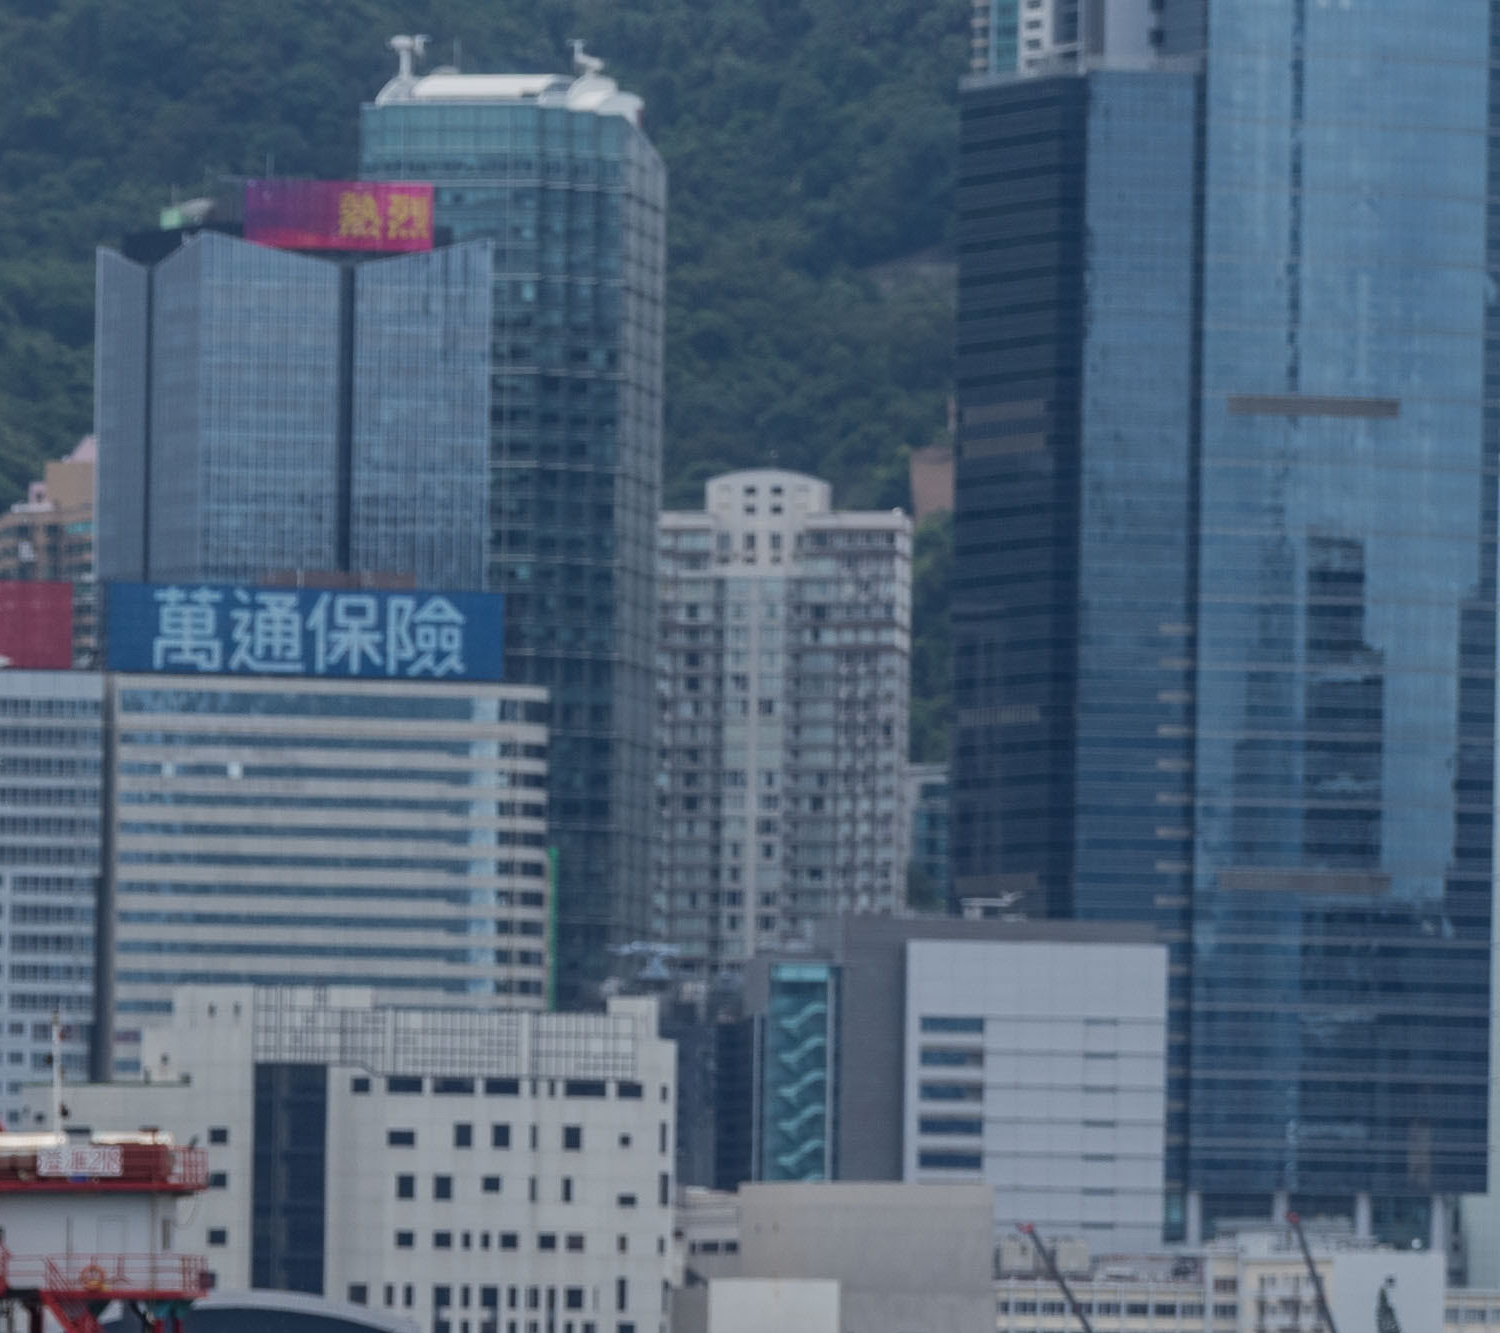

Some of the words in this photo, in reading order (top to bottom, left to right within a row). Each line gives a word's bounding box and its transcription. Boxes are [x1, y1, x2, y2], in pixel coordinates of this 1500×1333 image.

[339, 192, 429, 240] 熱烈
[152, 586, 466, 677] 萬通保險
